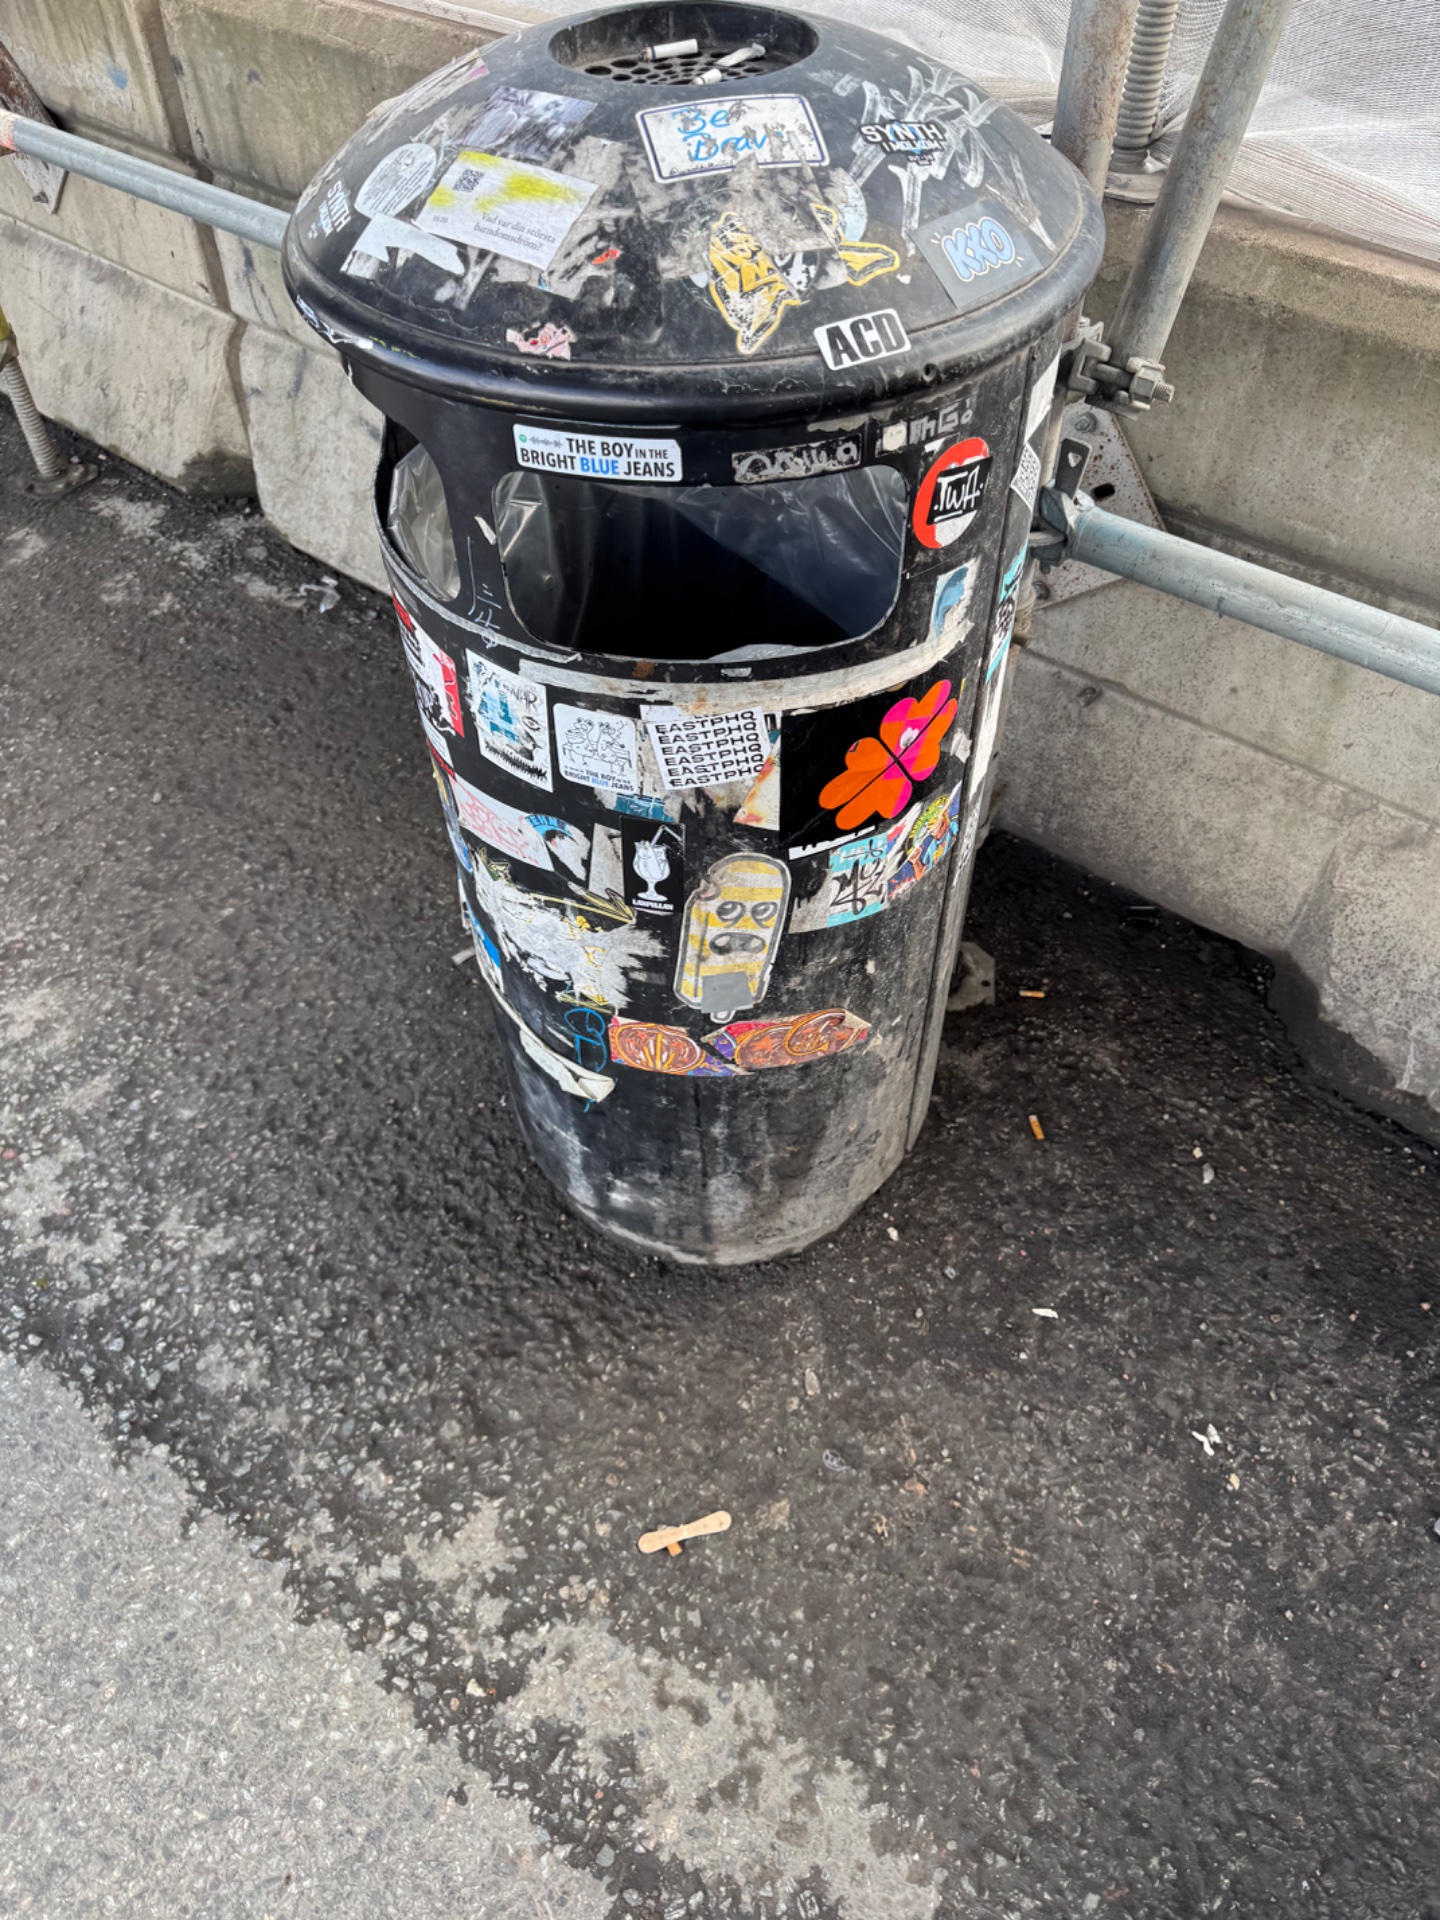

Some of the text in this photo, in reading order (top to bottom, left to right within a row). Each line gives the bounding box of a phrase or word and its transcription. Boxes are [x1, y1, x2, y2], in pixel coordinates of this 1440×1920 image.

[860, 123, 944, 142] SYNTH
[327, 180, 352, 233] SYNTH
[473, 222, 544, 251] barndomsdröm?
[481, 212, 497, 224] Vad
[511, 220, 526, 232] din
[526, 223, 557, 244] största
[941, 216, 1016, 282] KXO
[825, 312, 907, 368] ACD
[566, 437, 669, 460] THE BOY IN THE
[520, 447, 675, 478] BRIGHT BLUE JEANS
[655, 710, 757, 734] EASTPHQ
[658, 721, 758, 745] EASTPHQ
[661, 732, 760, 756] EASTPHQ
[664, 743, 763, 766] EASTPHQ
[667, 754, 764, 777] EASTPHQ
[611, 782, 635, 792] JEANS
